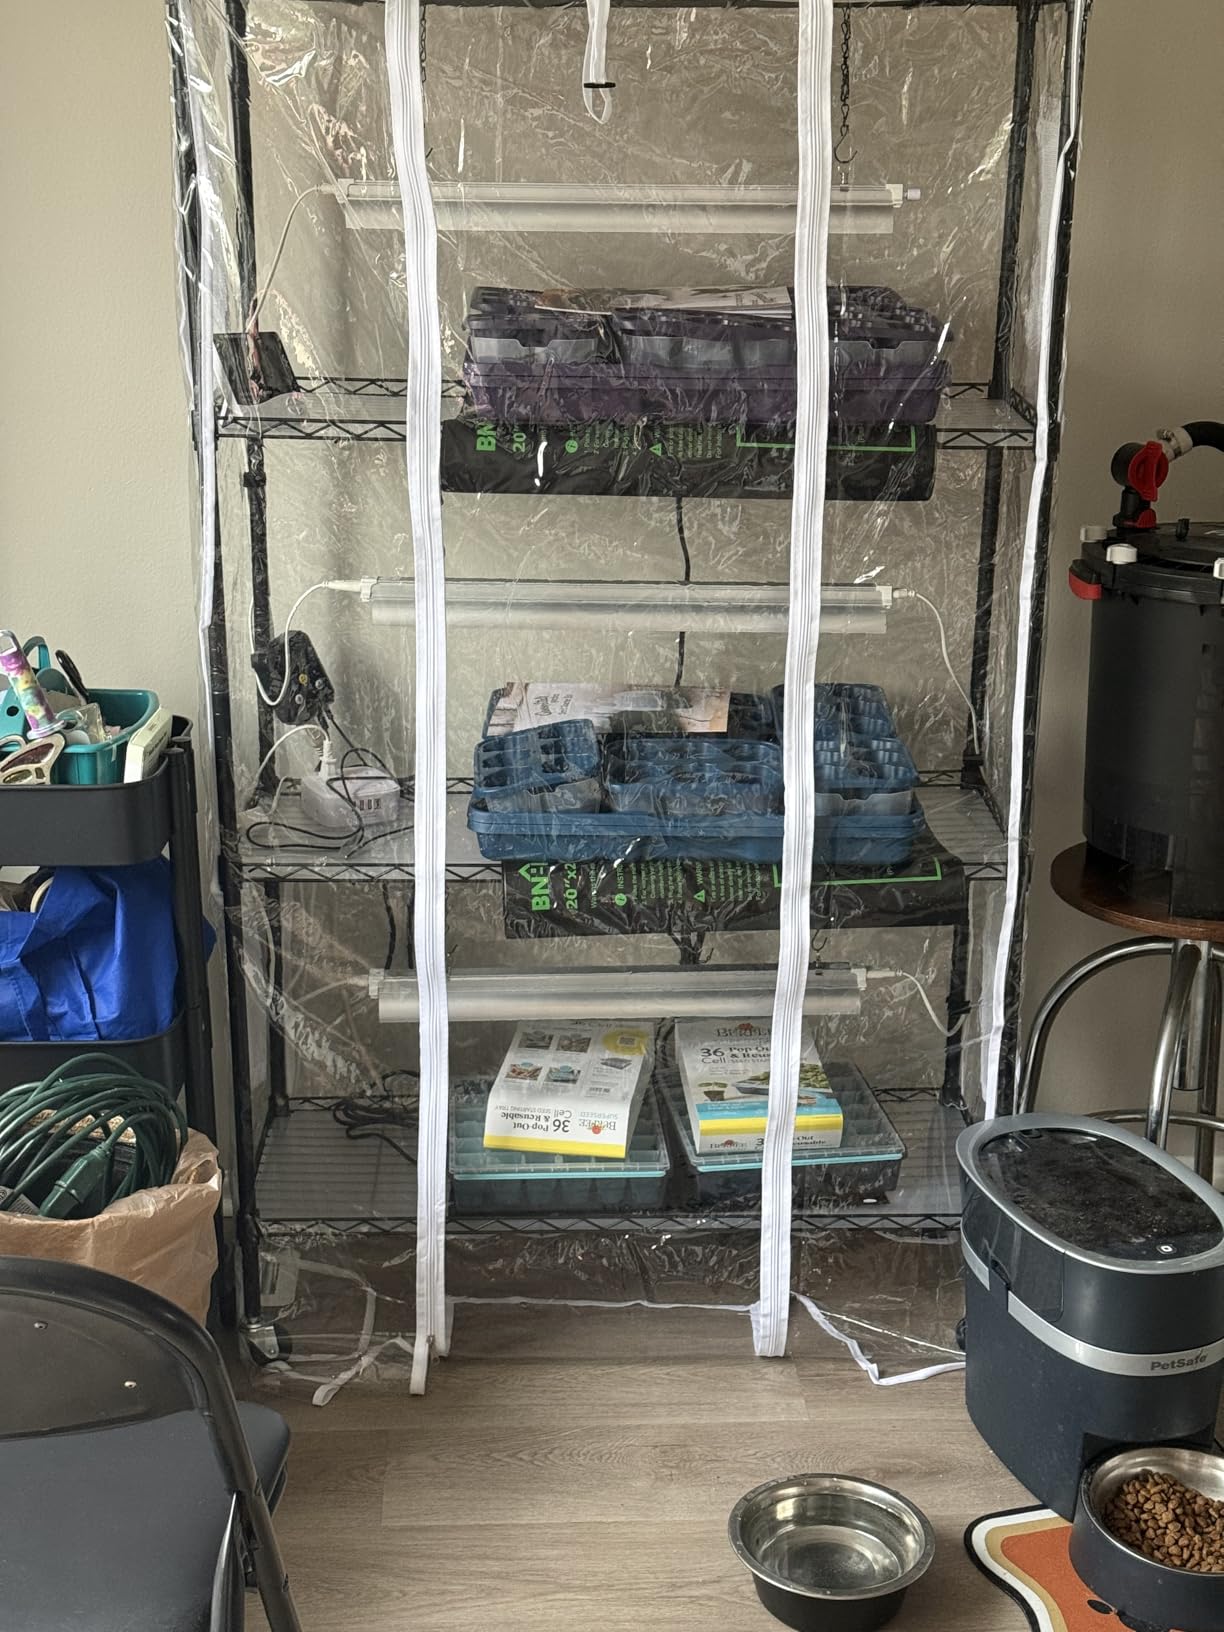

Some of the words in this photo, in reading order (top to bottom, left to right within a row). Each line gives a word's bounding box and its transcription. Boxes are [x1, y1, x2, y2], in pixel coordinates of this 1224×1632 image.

[700, 1047, 725, 1058] 36
[500, 1111, 541, 1123] Reusable
[554, 1108, 573, 1119] Cell
[552, 1118, 571, 1133] 36
[1150, 1349, 1209, 1371] PetSafe
